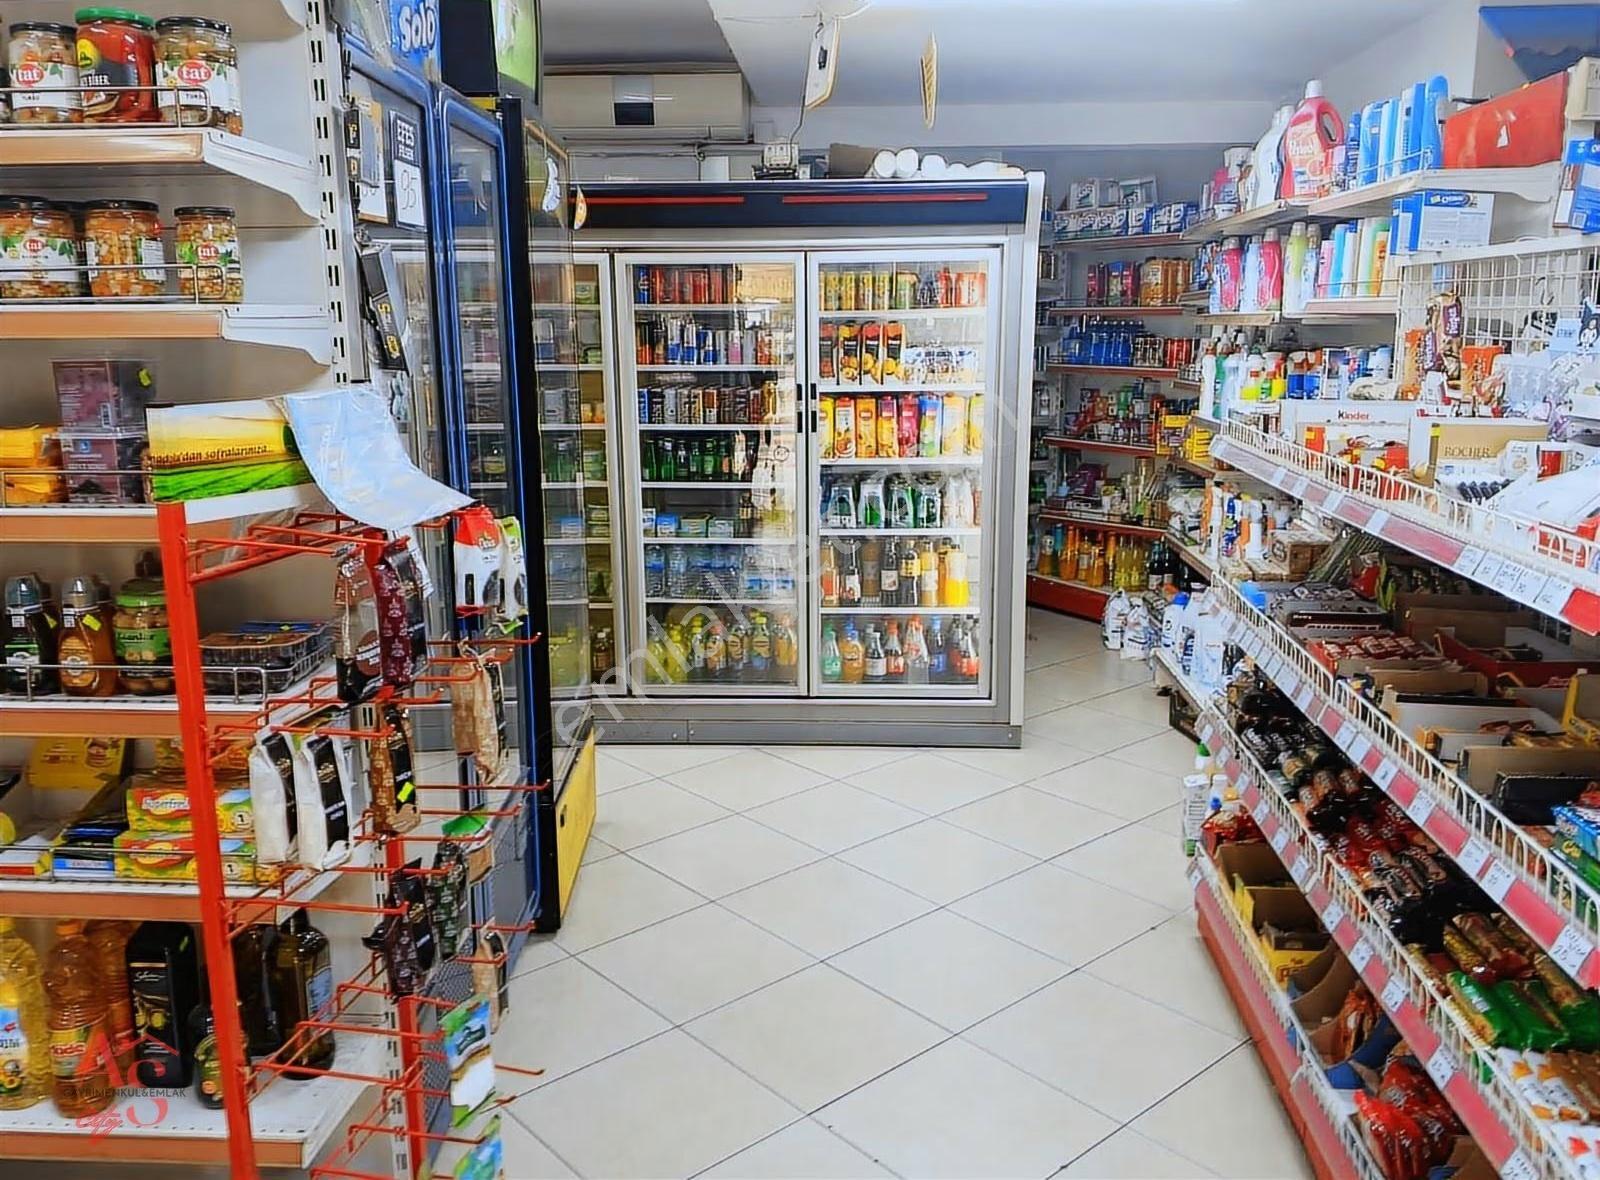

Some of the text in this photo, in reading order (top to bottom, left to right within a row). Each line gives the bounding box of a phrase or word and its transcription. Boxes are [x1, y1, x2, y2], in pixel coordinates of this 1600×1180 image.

[398, 5, 437, 51] Solo
[18, 67, 43, 82] tat
[182, 66, 210, 81] tat
[1444, 446, 1490, 458] ROCHER
